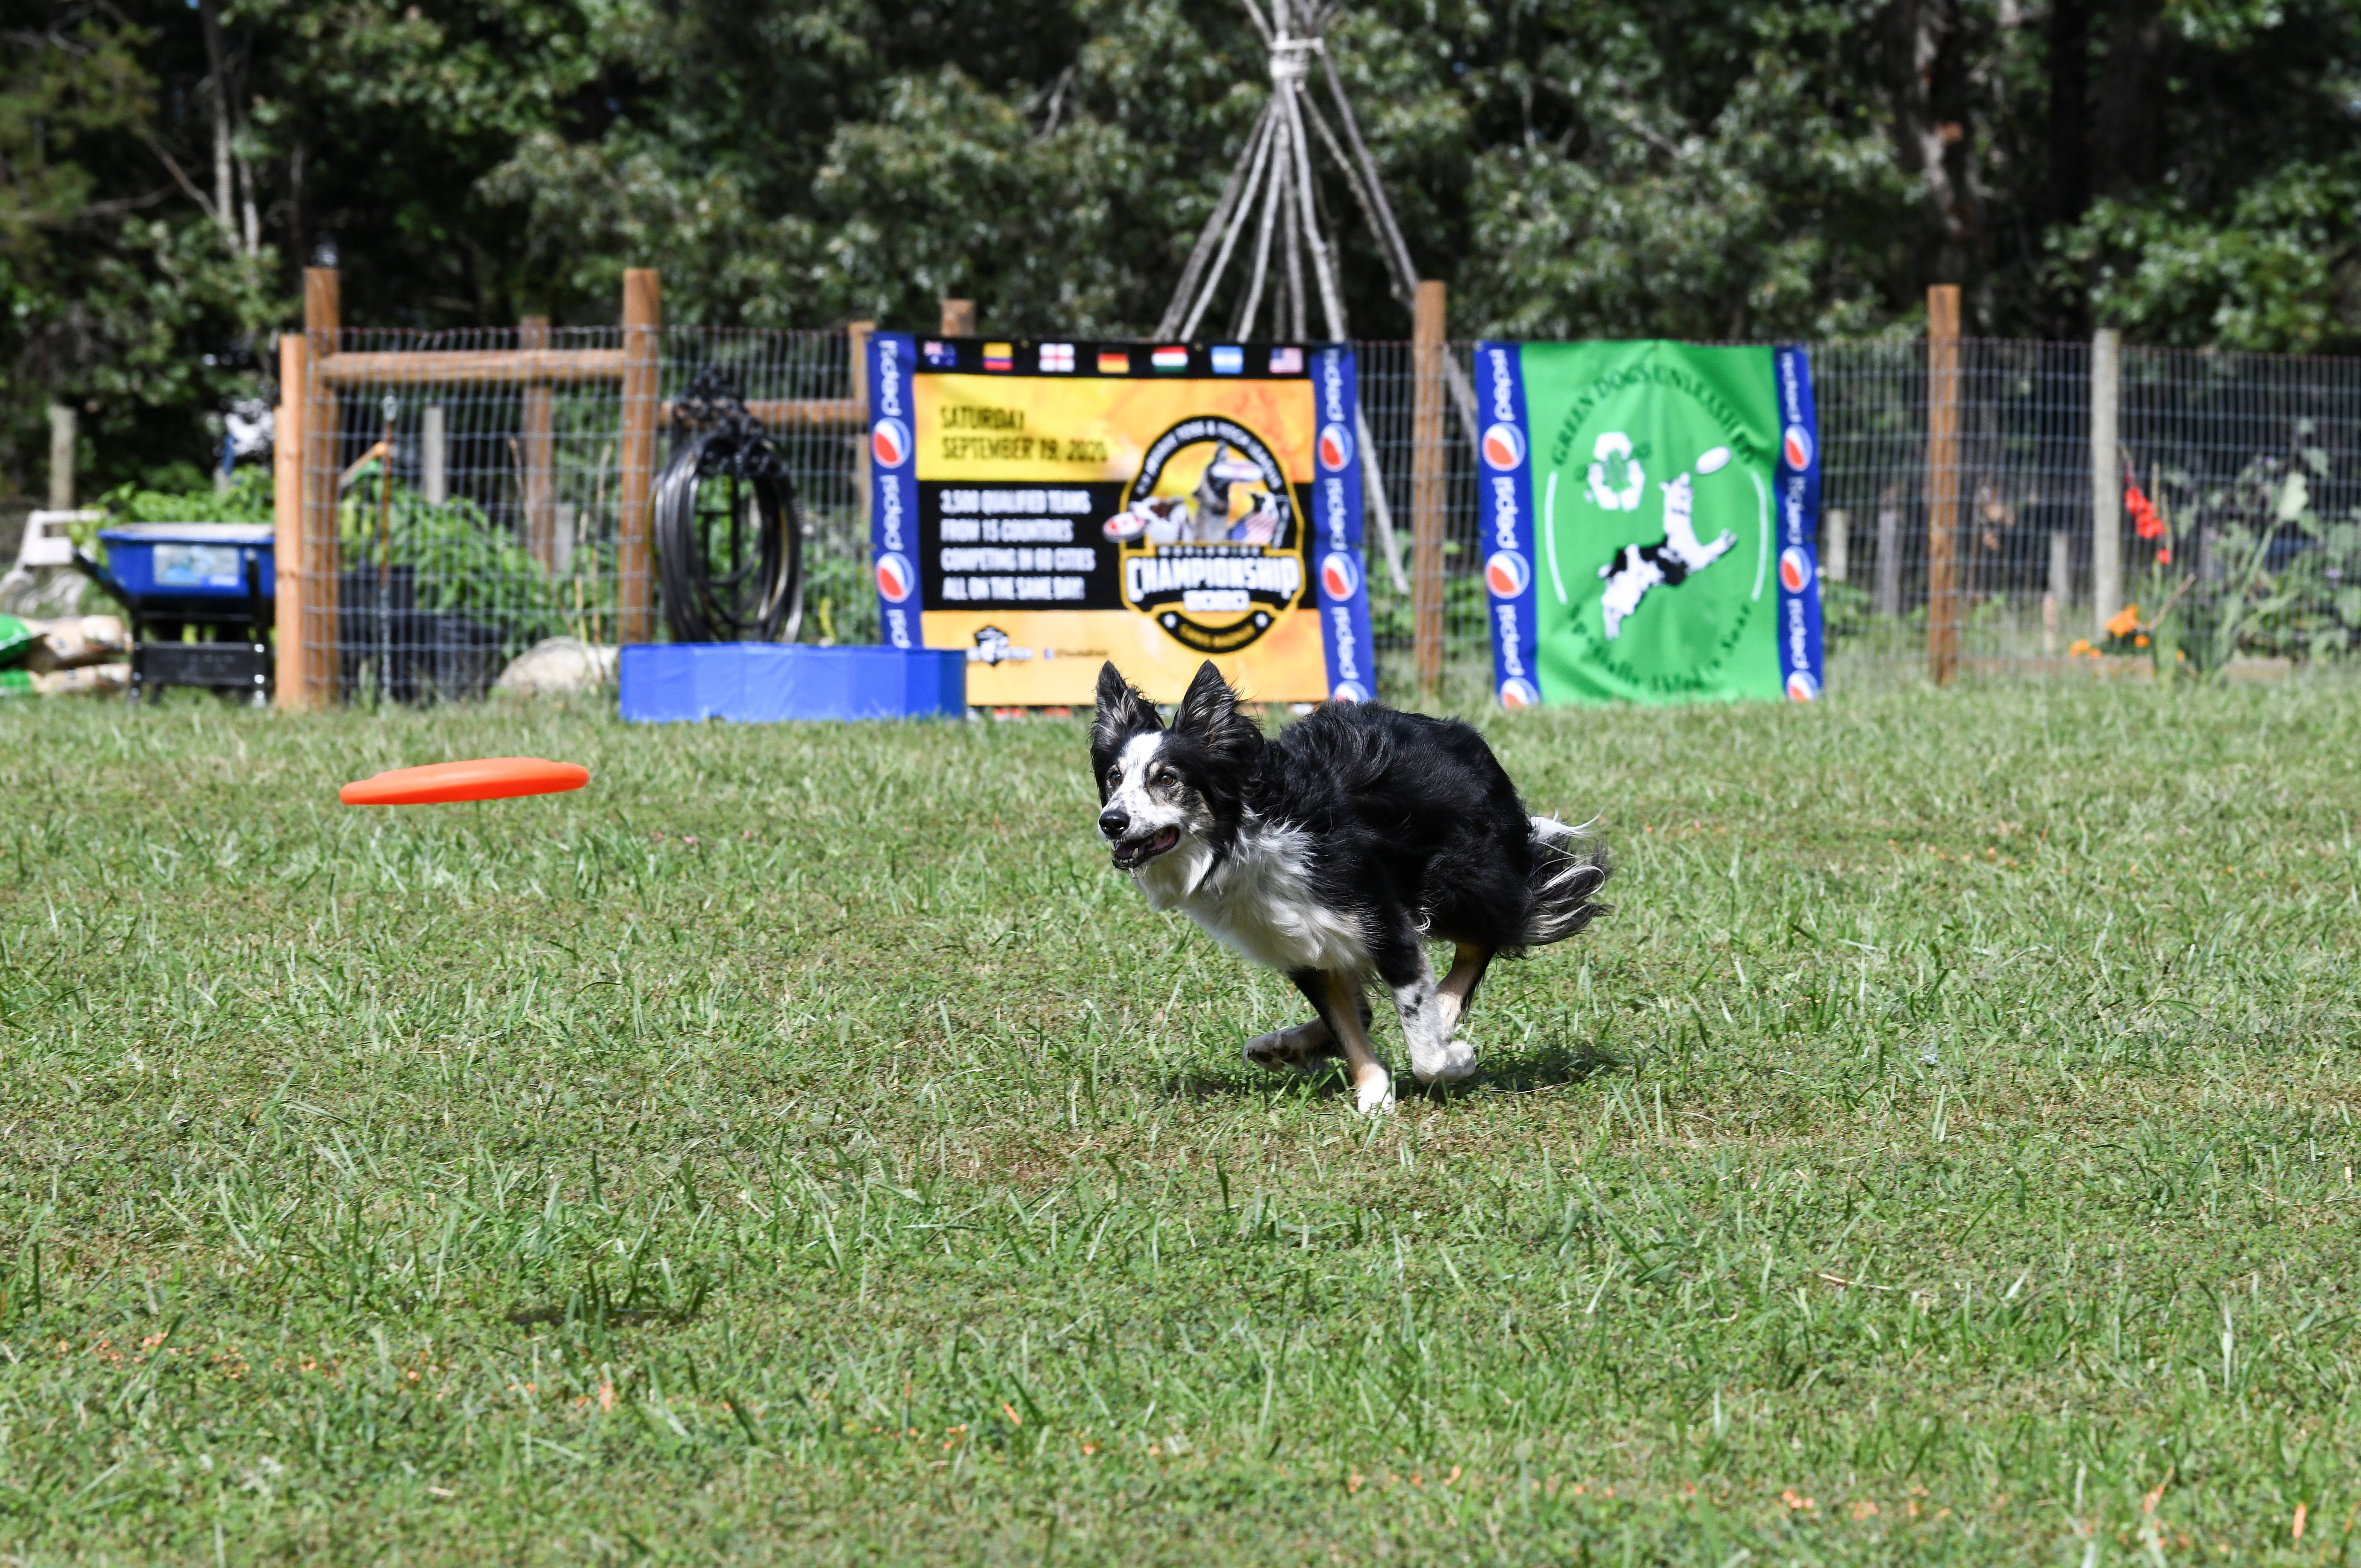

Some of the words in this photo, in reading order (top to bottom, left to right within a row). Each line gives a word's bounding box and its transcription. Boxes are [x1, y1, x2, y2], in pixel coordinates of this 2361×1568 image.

[878, 339, 903, 417] pepsi
[1489, 348, 1516, 422] pepsi
[942, 436, 1034, 461] SEPTEMBER
[879, 474, 904, 551] pepsi
[1492, 477, 1519, 550] pepsi
[1126, 557, 1300, 602] CHAMPIONSHIP
[1331, 606, 1360, 680] pepsi
[1496, 604, 1525, 676] pepsi
